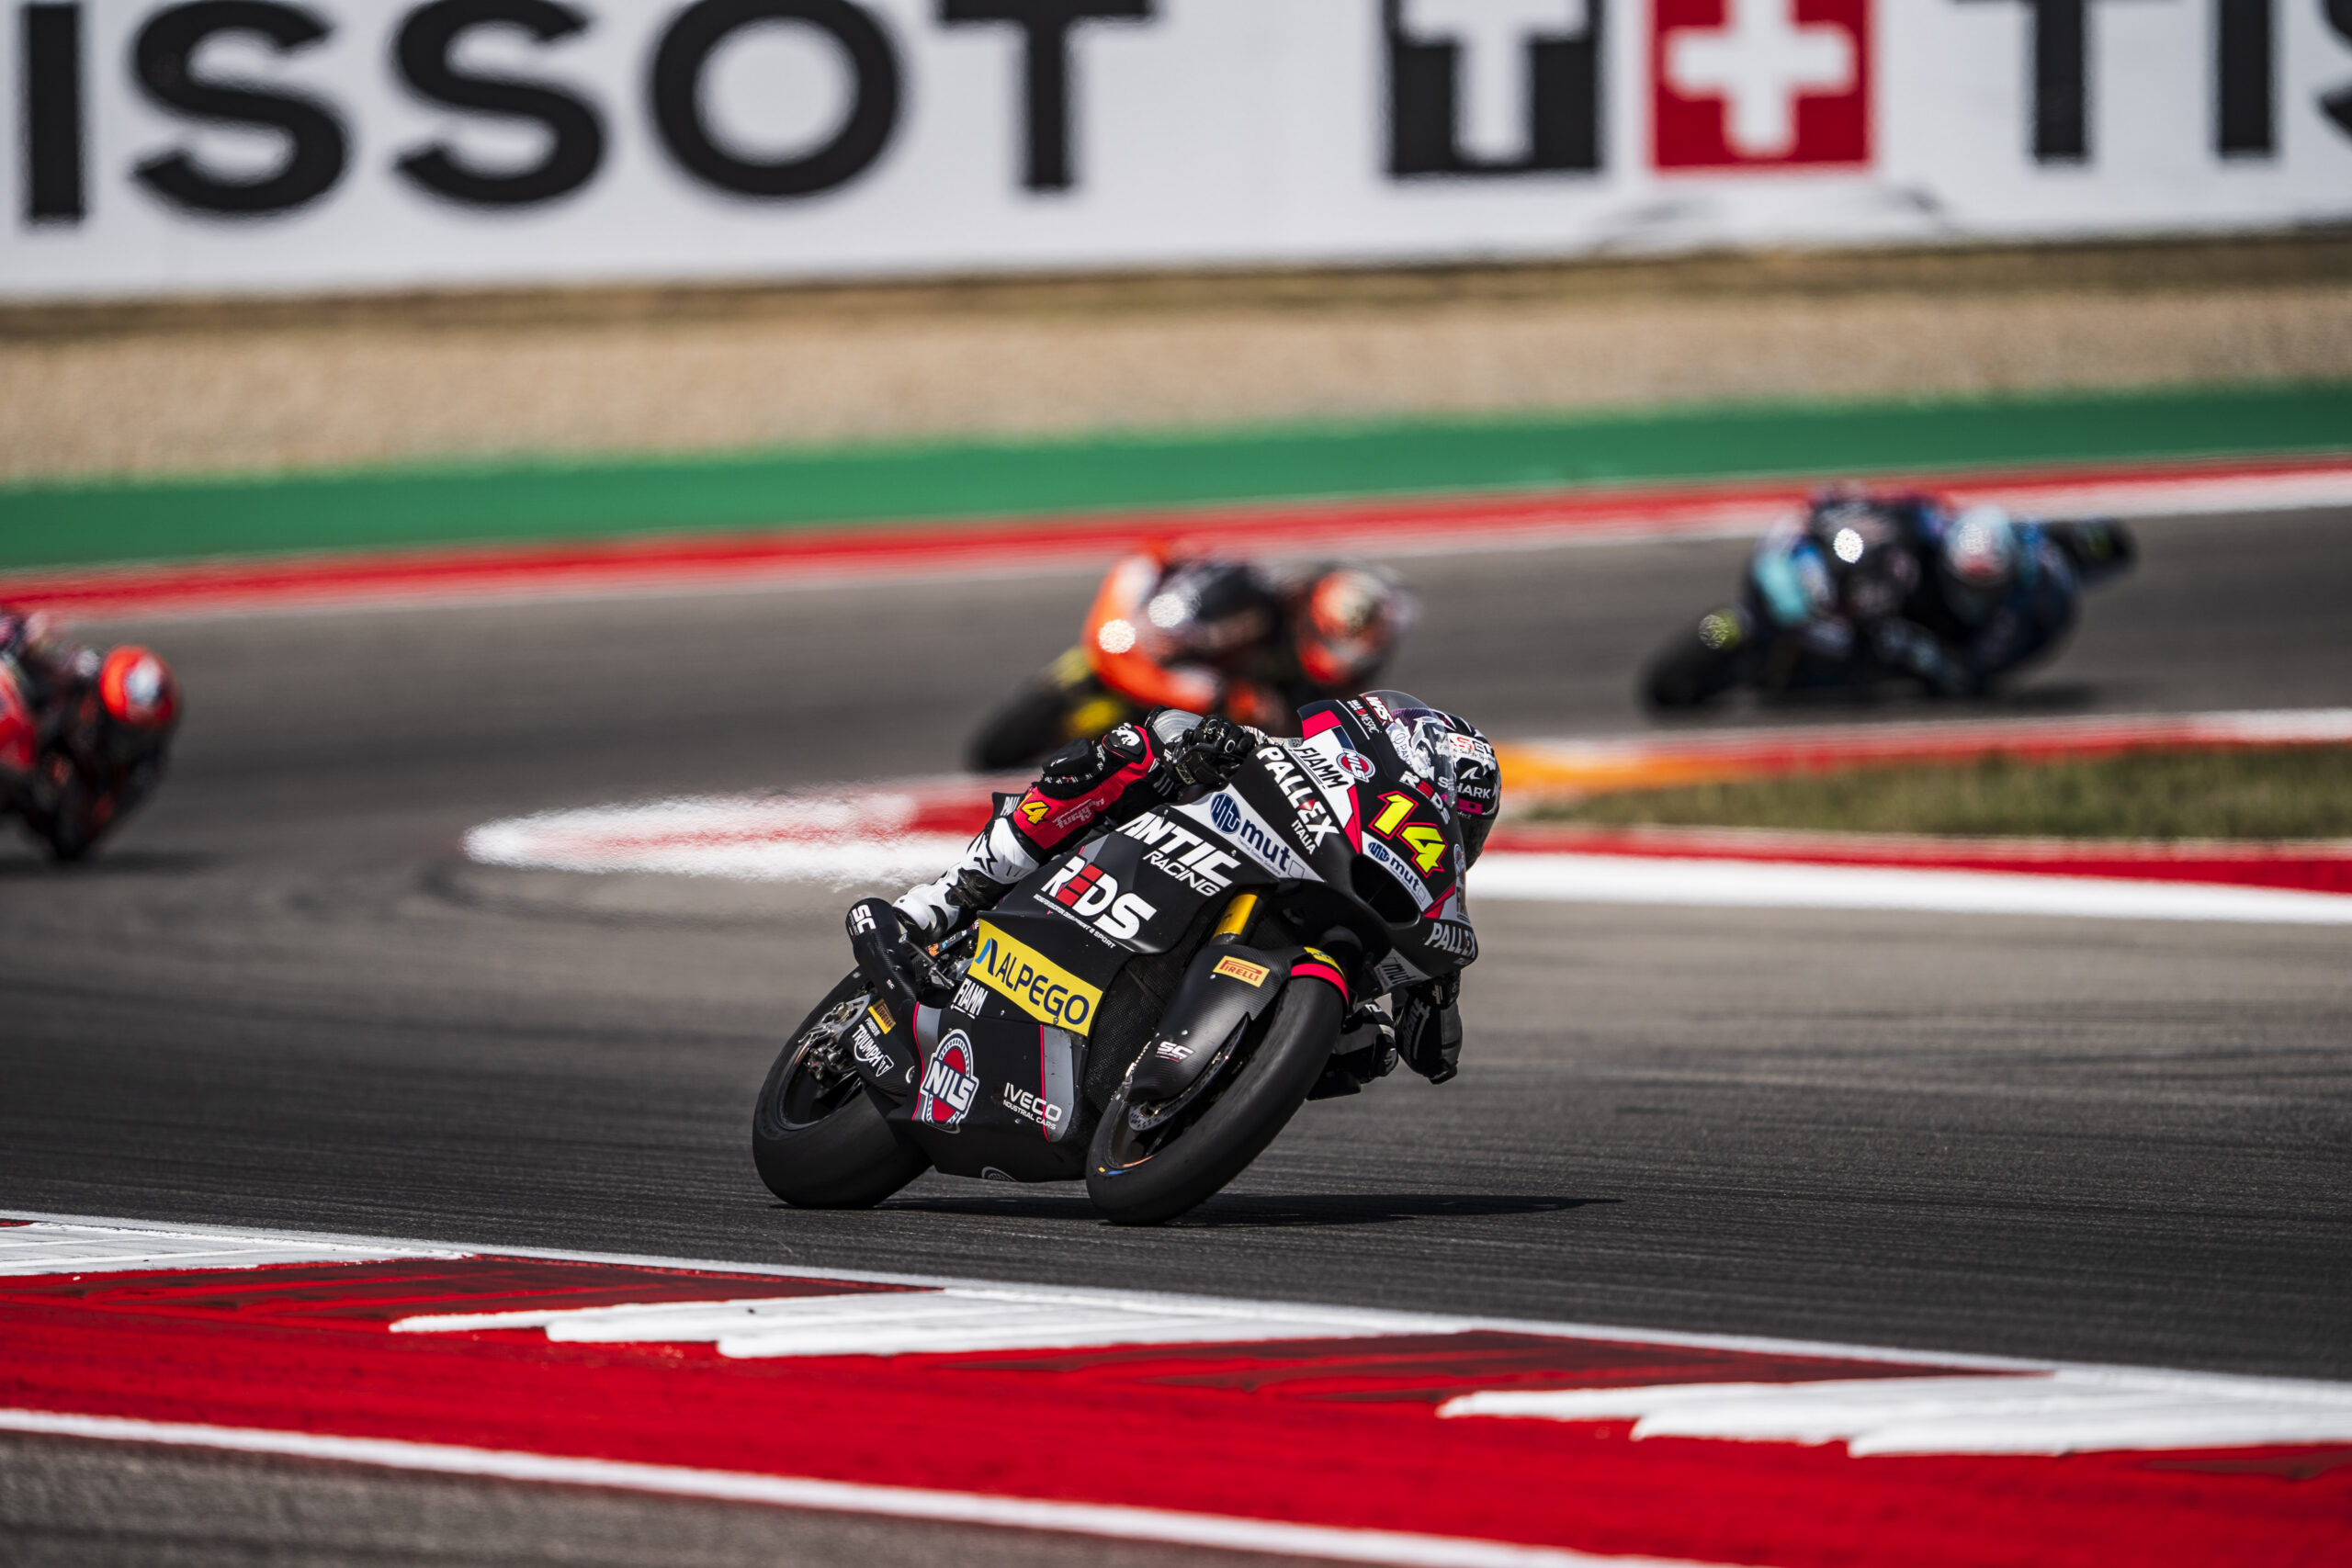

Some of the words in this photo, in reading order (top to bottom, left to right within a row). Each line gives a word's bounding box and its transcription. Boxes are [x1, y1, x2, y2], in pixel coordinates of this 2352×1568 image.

[1955, 0, 2352, 164] TI
[1294, 747, 1349, 789] FIAMM
[1345, 751, 1367, 780] NILS
[1256, 746, 1340, 847] PALLEX
[1438, 776, 1492, 799] SHARK
[1017, 791, 1051, 826] 4
[1114, 811, 1241, 887] ANTIC
[1239, 818, 1291, 872] mut
[1291, 818, 1317, 855] ITALIA
[1369, 791, 1448, 878] 14
[1142, 850, 1221, 897] RACING
[1390, 856, 1419, 891] mut
[1040, 855, 1157, 940] REDS
[852, 904, 876, 934] SC
[1093, 931, 1116, 949] SPORT
[995, 953, 1090, 1025] ALPEGO
[1219, 959, 1263, 982] PIRELLI
[953, 977, 989, 1016] FIAMM
[852, 1023, 885, 1067] TRIUMPH
[1158, 1041, 1195, 1058] SC
[924, 1060, 975, 1111] NILS
[1003, 1081, 1062, 1122] IVECO
[1035, 1116, 1057, 1131] CARS
